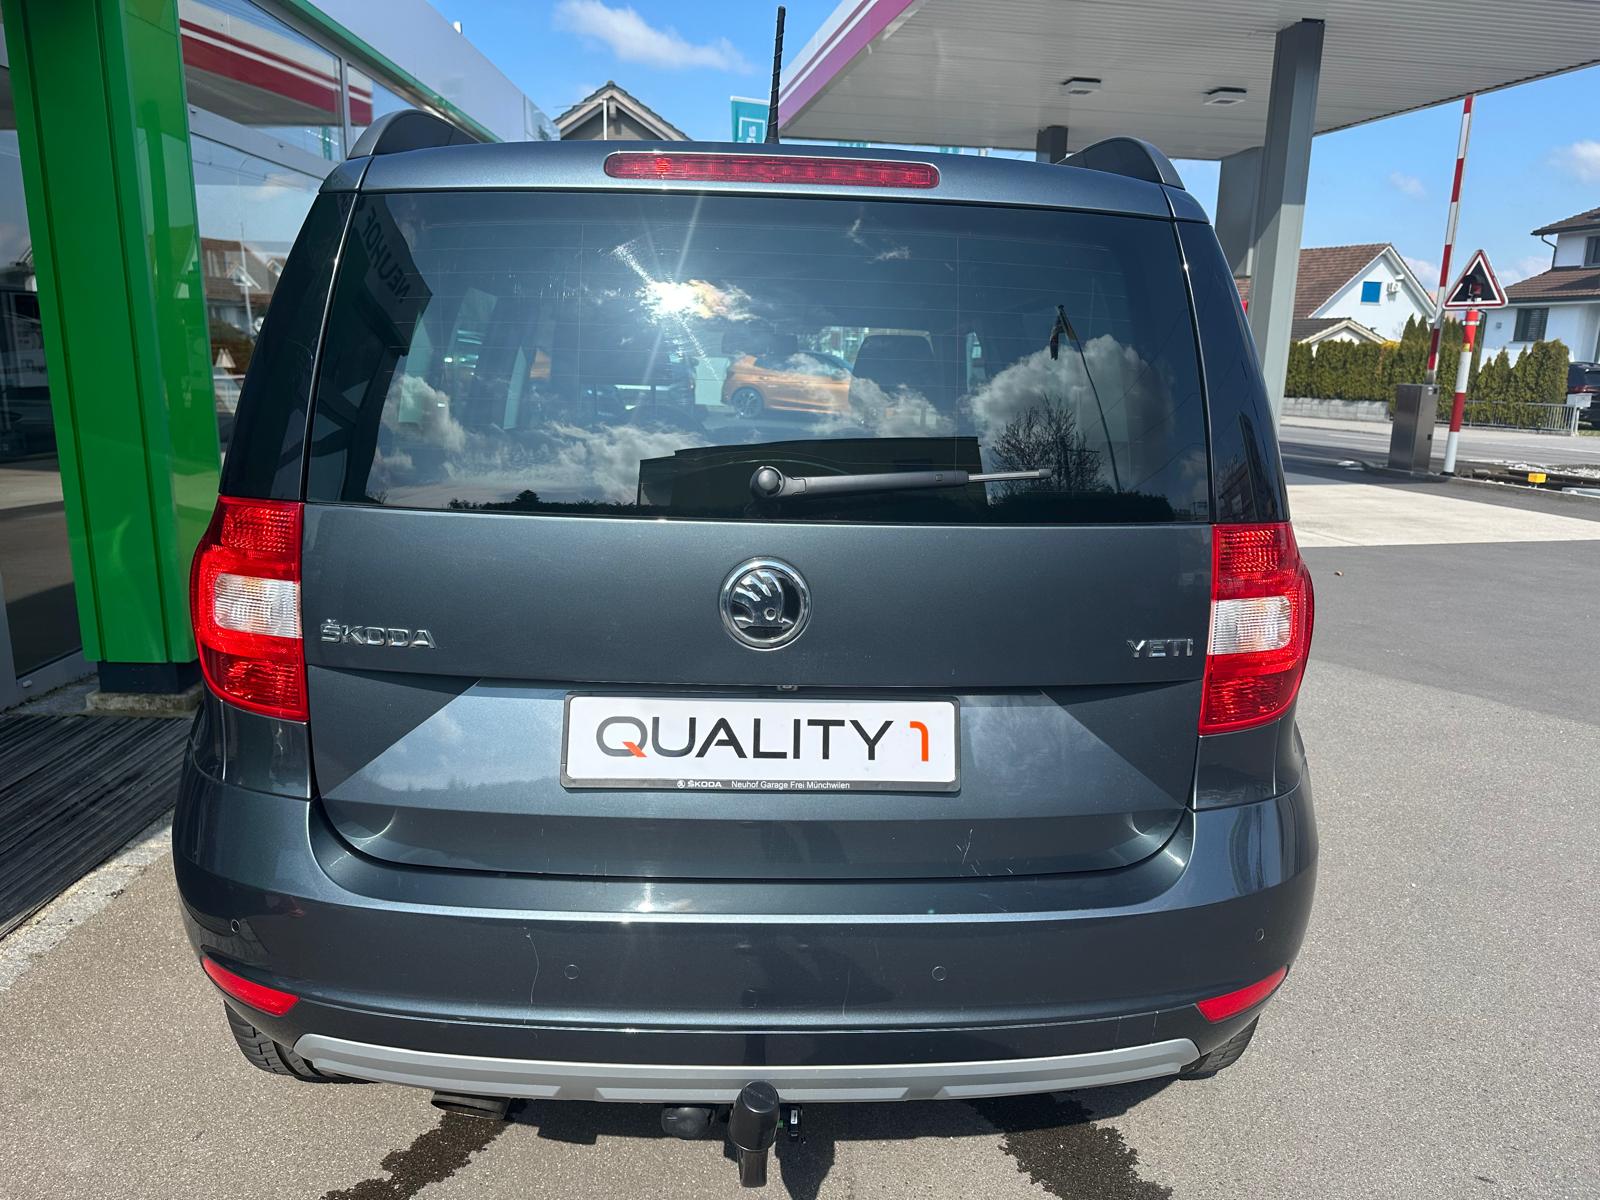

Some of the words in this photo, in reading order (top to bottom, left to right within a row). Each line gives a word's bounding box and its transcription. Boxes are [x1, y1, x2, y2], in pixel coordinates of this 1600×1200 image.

[319, 618, 436, 650] ŠKODA
[1126, 638, 1194, 658] YETI
[595, 715, 894, 761] QUALITY
[909, 720, 929, 762] 1
[731, 780, 759, 789] Neuhof
[760, 781, 788, 790] Garage
[790, 781, 805, 789] Frei
[806, 781, 850, 789] Münchwilen
